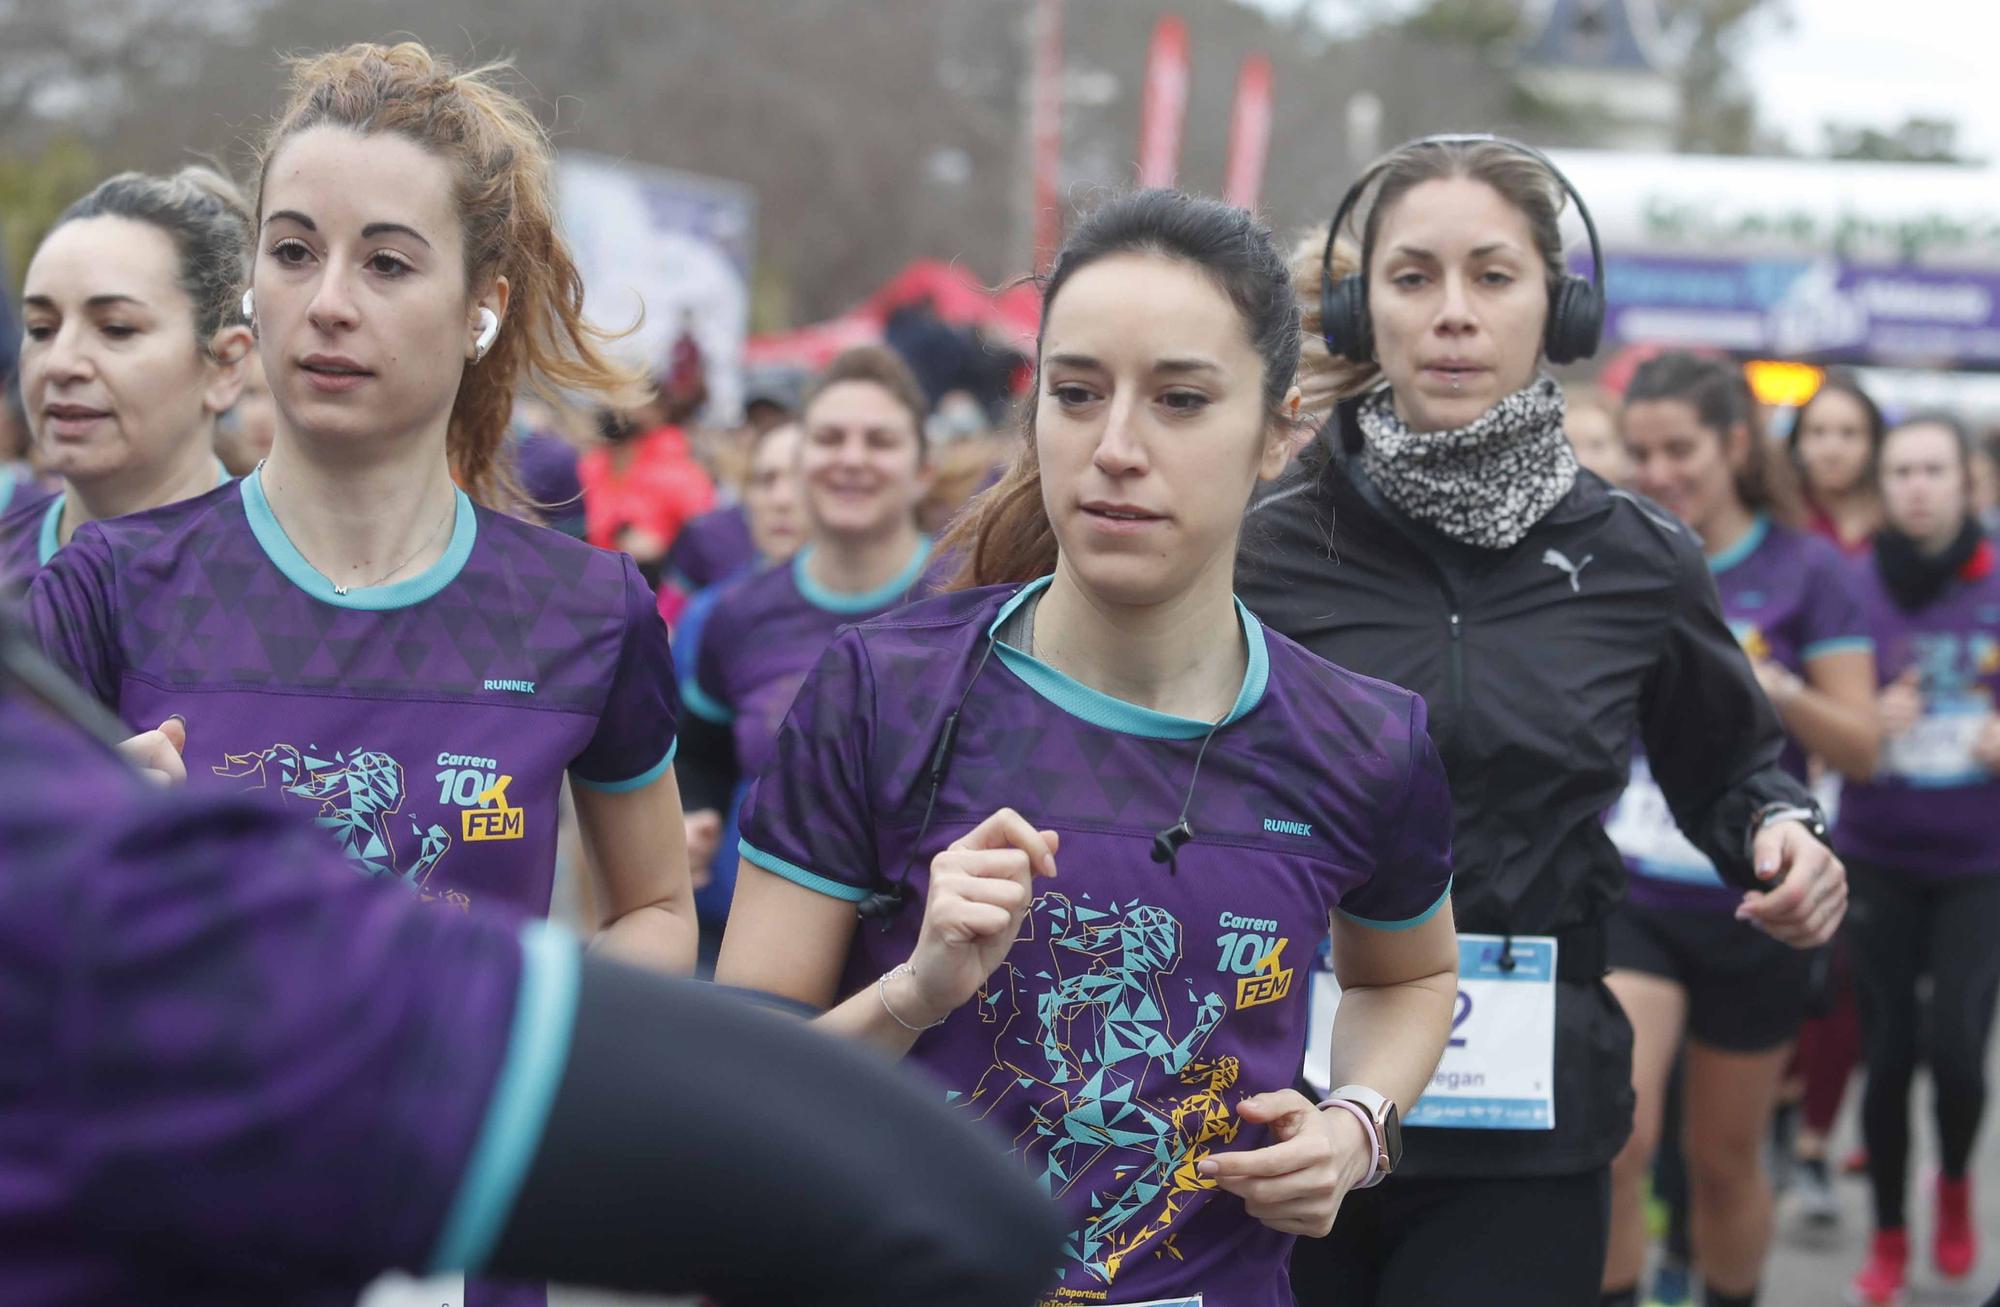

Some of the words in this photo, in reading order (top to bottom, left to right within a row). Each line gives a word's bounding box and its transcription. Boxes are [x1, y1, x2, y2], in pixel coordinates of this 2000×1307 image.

[483, 679, 536, 694] RUNNEK
[436, 751, 498, 770] Carrera
[435, 768, 513, 809] 10K
[466, 810, 522, 837] FEM
[1263, 817, 1313, 837] RUNNEK
[1218, 911, 1278, 933] Carrera
[1216, 931, 1289, 976] 10K
[1239, 971, 1290, 1006] FEM
